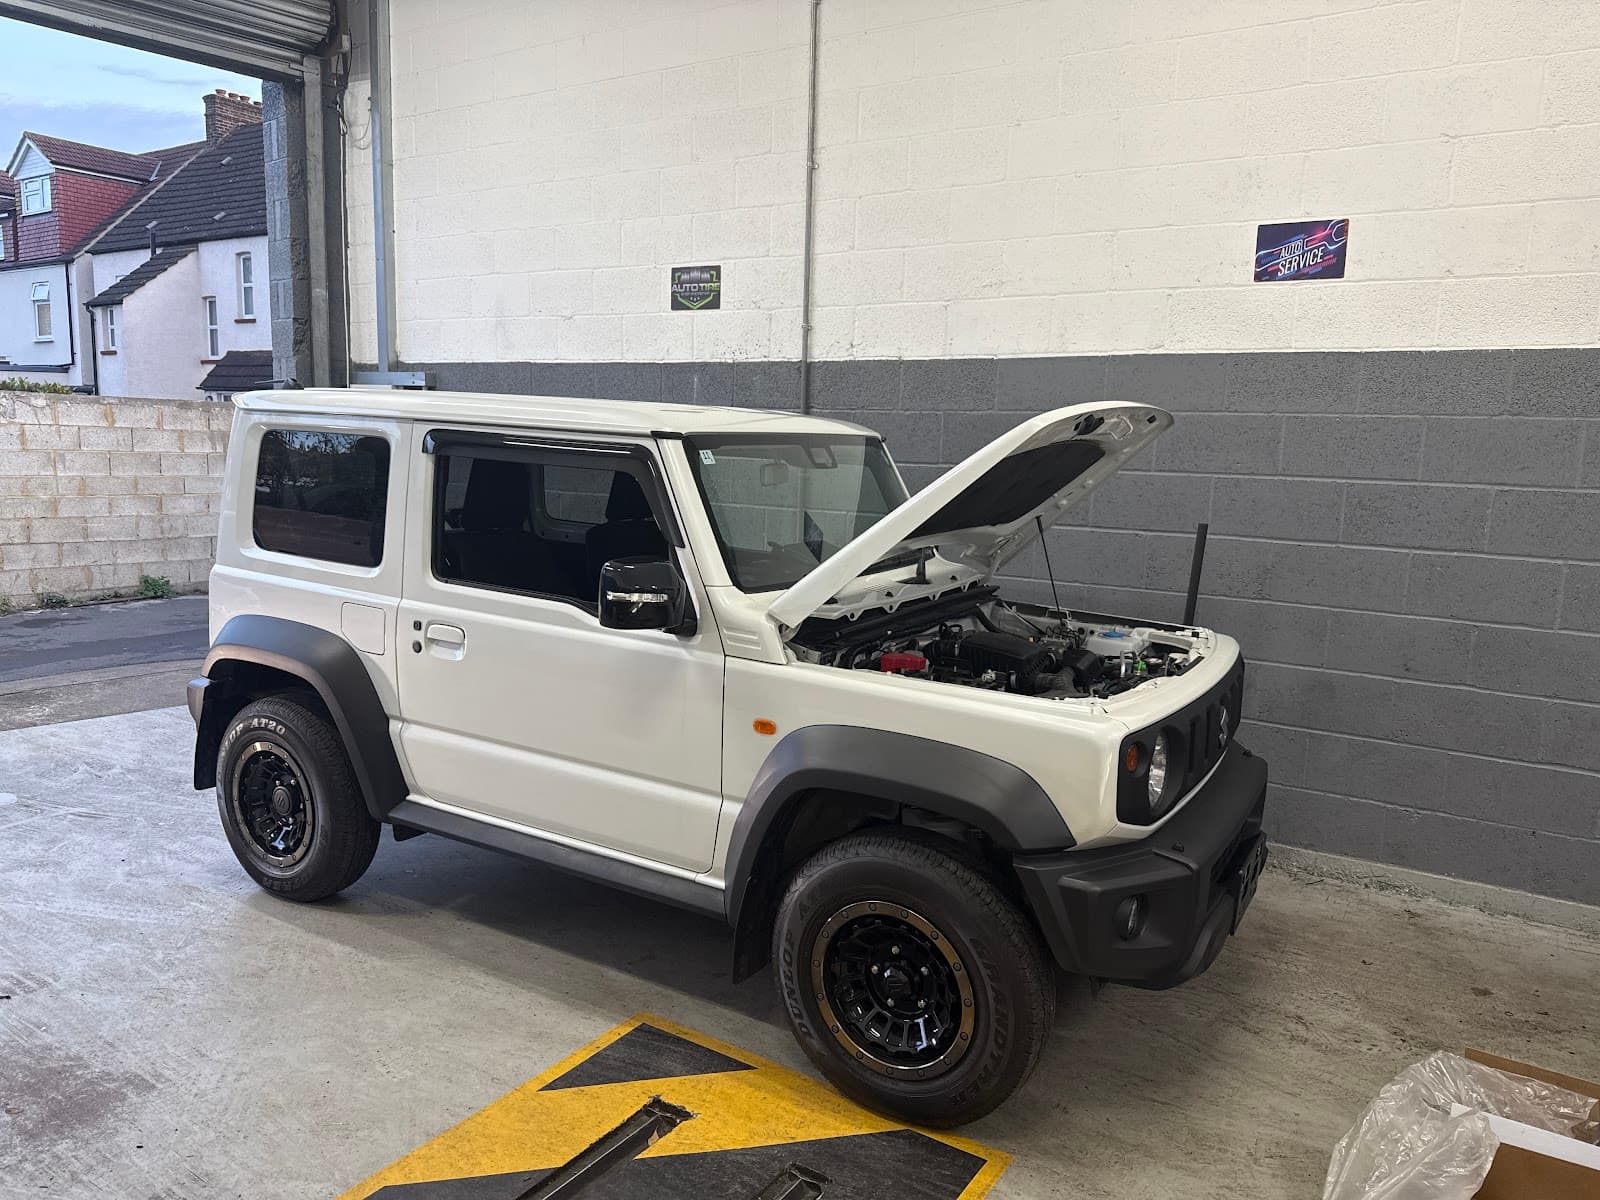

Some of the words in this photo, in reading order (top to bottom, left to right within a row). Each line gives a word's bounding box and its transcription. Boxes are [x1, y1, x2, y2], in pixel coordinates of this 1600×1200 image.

[1277, 246, 1326, 276] SERVICE
[1280, 242, 1302, 258] AUTO
[250, 718, 286, 735] AT20
[783, 931, 813, 1036] DUNLOP
